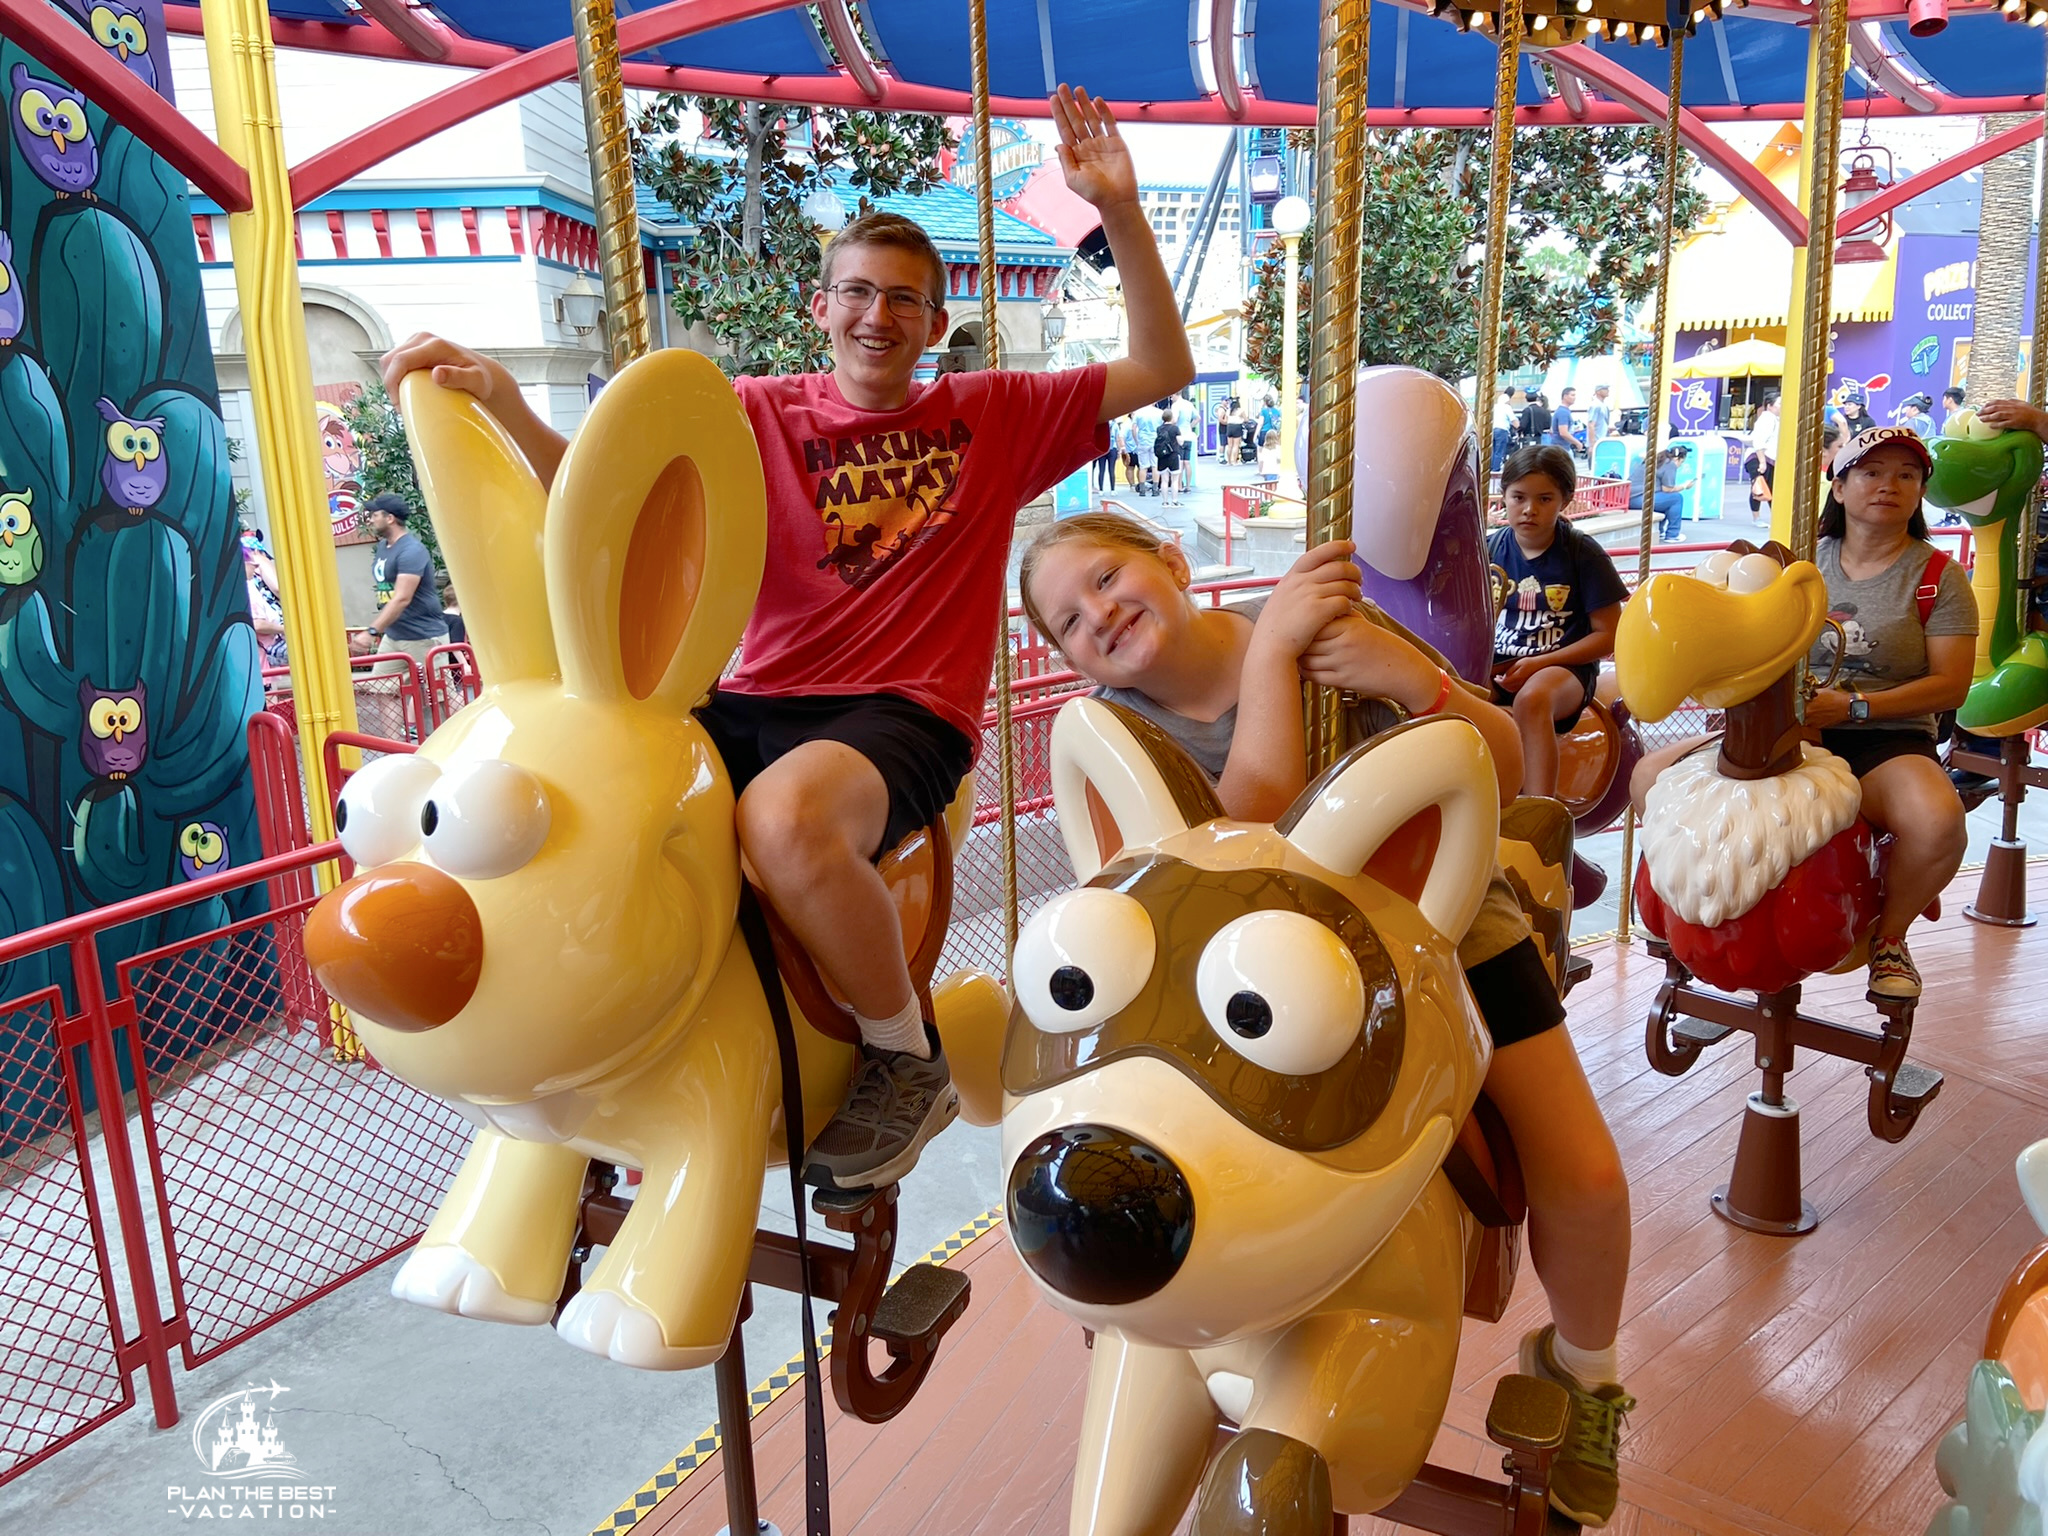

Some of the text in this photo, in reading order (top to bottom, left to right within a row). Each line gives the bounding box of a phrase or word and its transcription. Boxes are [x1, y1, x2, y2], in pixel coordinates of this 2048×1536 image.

[991, 129, 1011, 148] WAY
[1923, 261, 1970, 302] PRIZE
[803, 418, 973, 474] HAKUNA
[815, 453, 965, 509] MATAT
